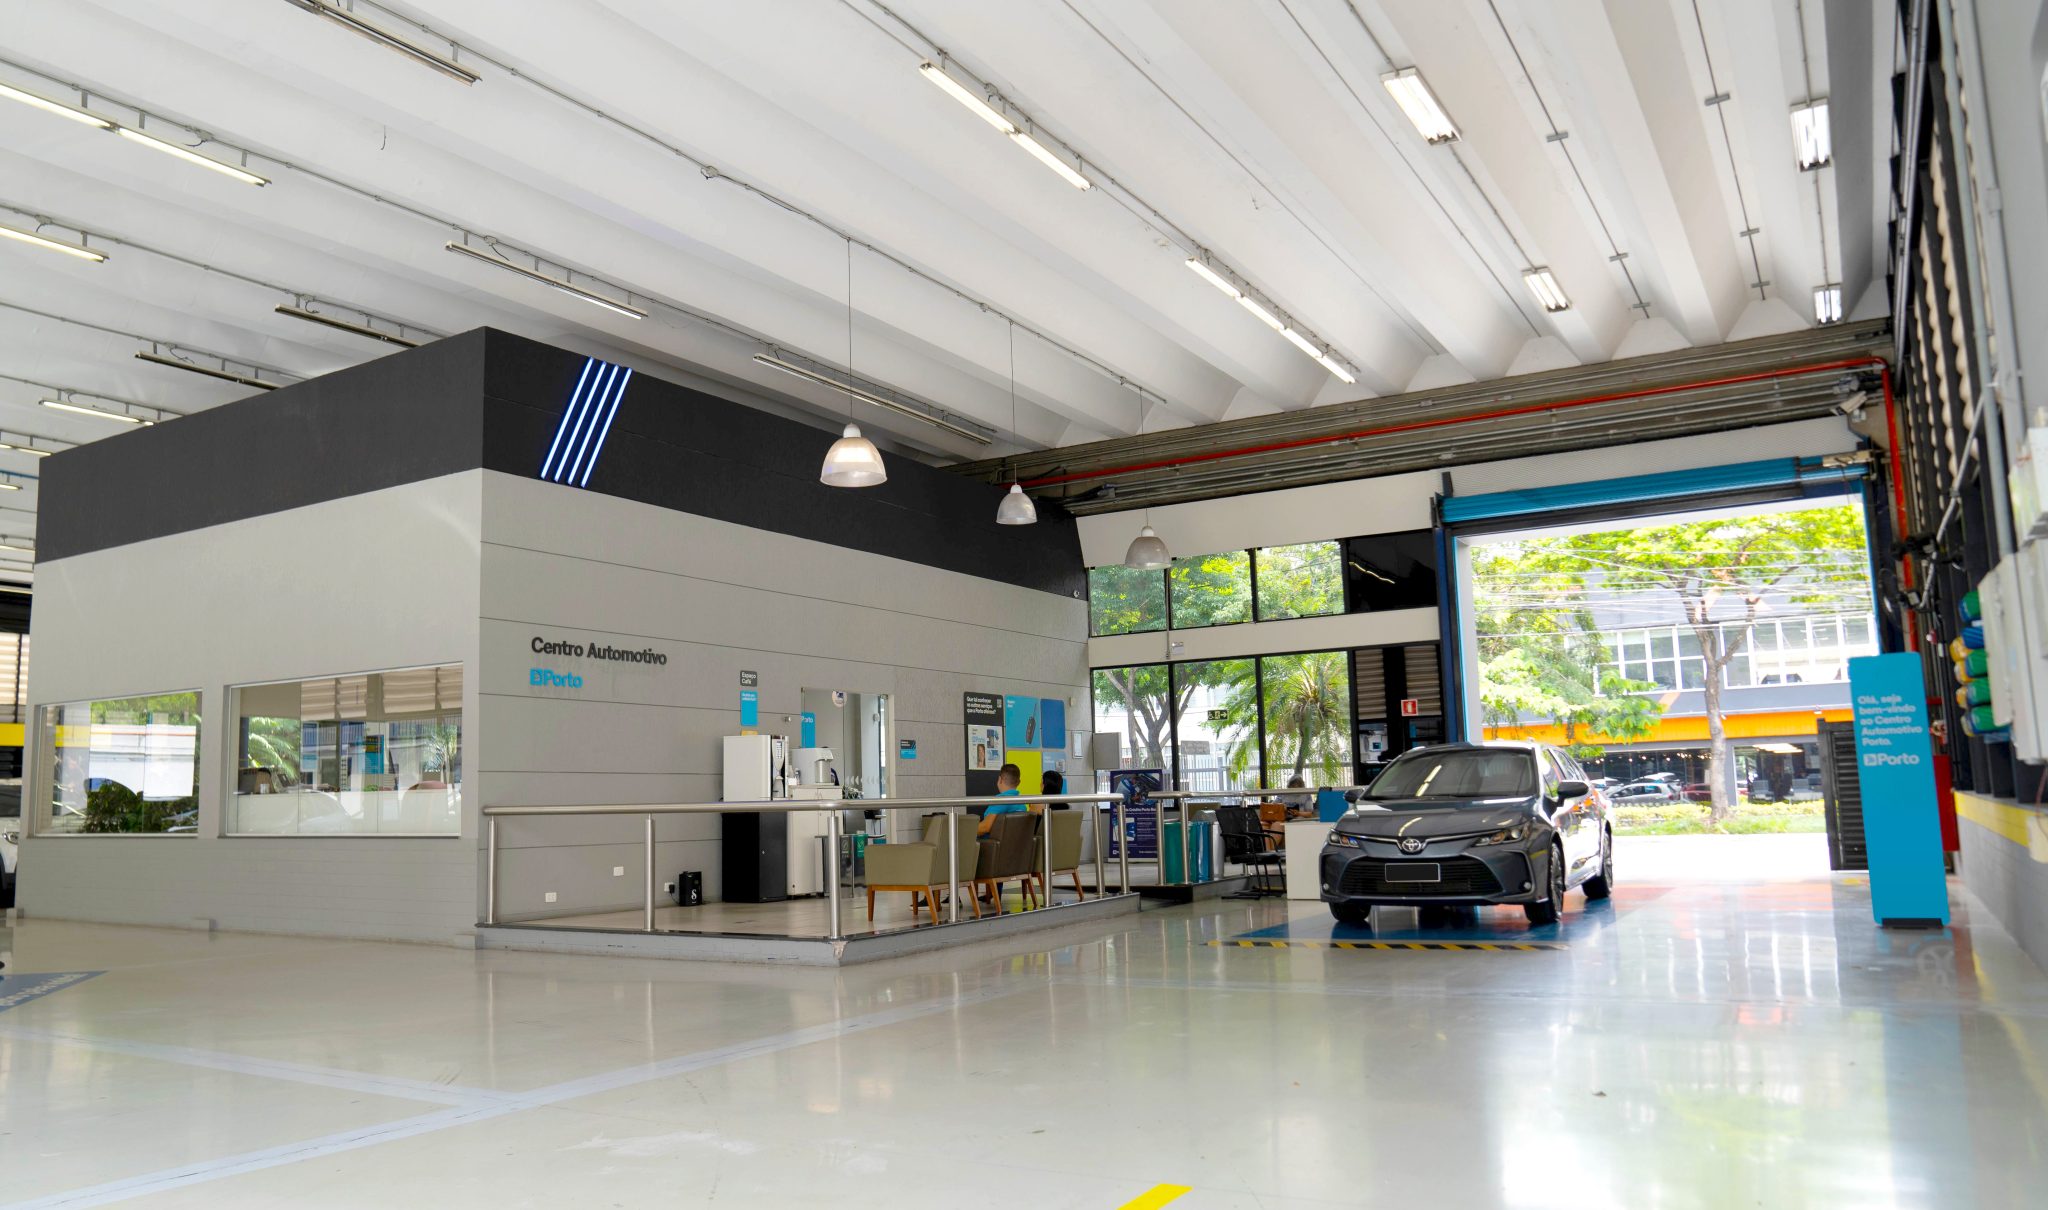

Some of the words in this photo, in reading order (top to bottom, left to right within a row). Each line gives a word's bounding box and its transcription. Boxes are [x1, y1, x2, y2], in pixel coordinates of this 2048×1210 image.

[531, 636, 584, 657] Centro
[586, 642, 668, 665] Automotivo
[543, 669, 583, 688] Porto
[1859, 704, 1916, 715] bem-vindo
[1874, 716, 1912, 725] Centro
[1861, 725, 1923, 736] Automotivo
[1877, 752, 1920, 766] Porto
